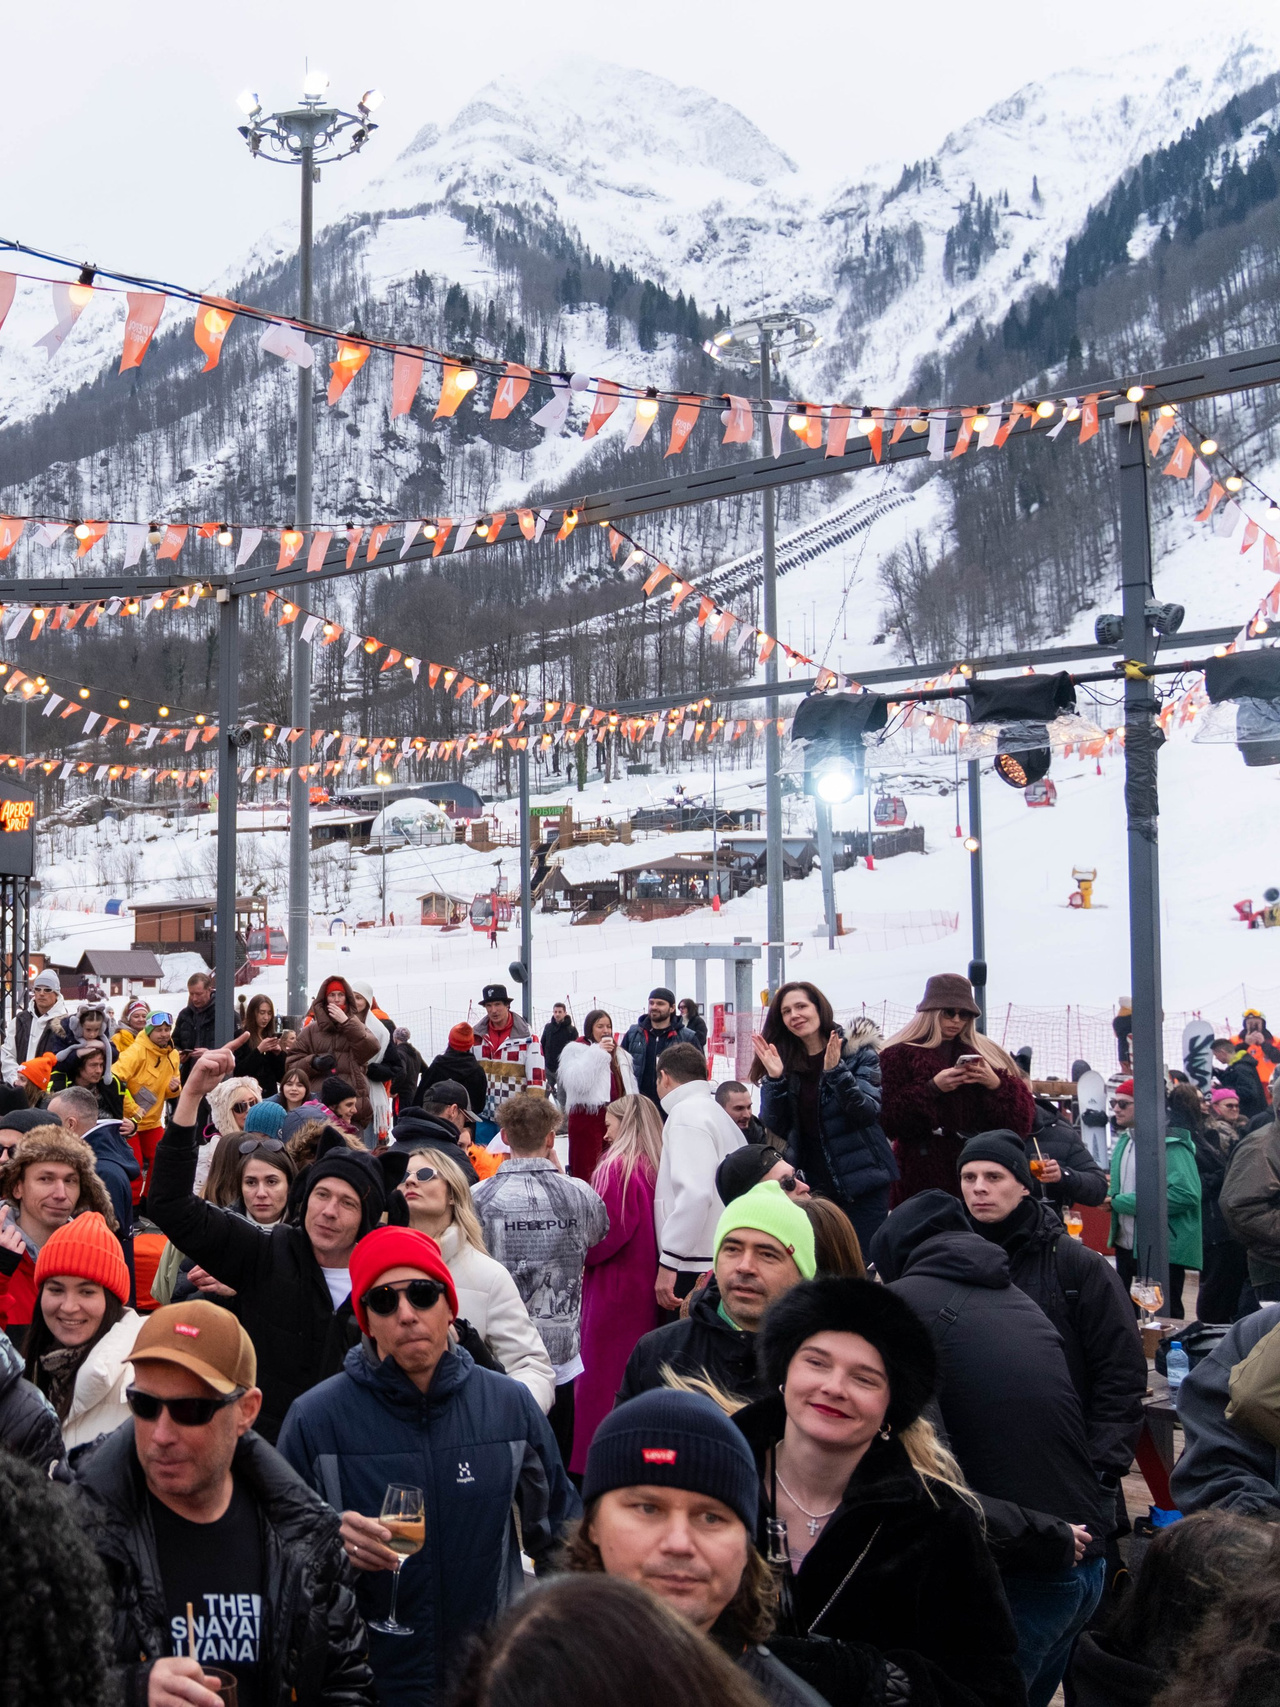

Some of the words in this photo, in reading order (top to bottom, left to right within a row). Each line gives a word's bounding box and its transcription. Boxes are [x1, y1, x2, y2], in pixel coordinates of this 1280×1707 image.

[499, 376, 514, 408] A
[1, 800, 35, 822] APEROL
[203, 1593, 253, 1617] THE
[172, 1639, 255, 1662] LYANA
